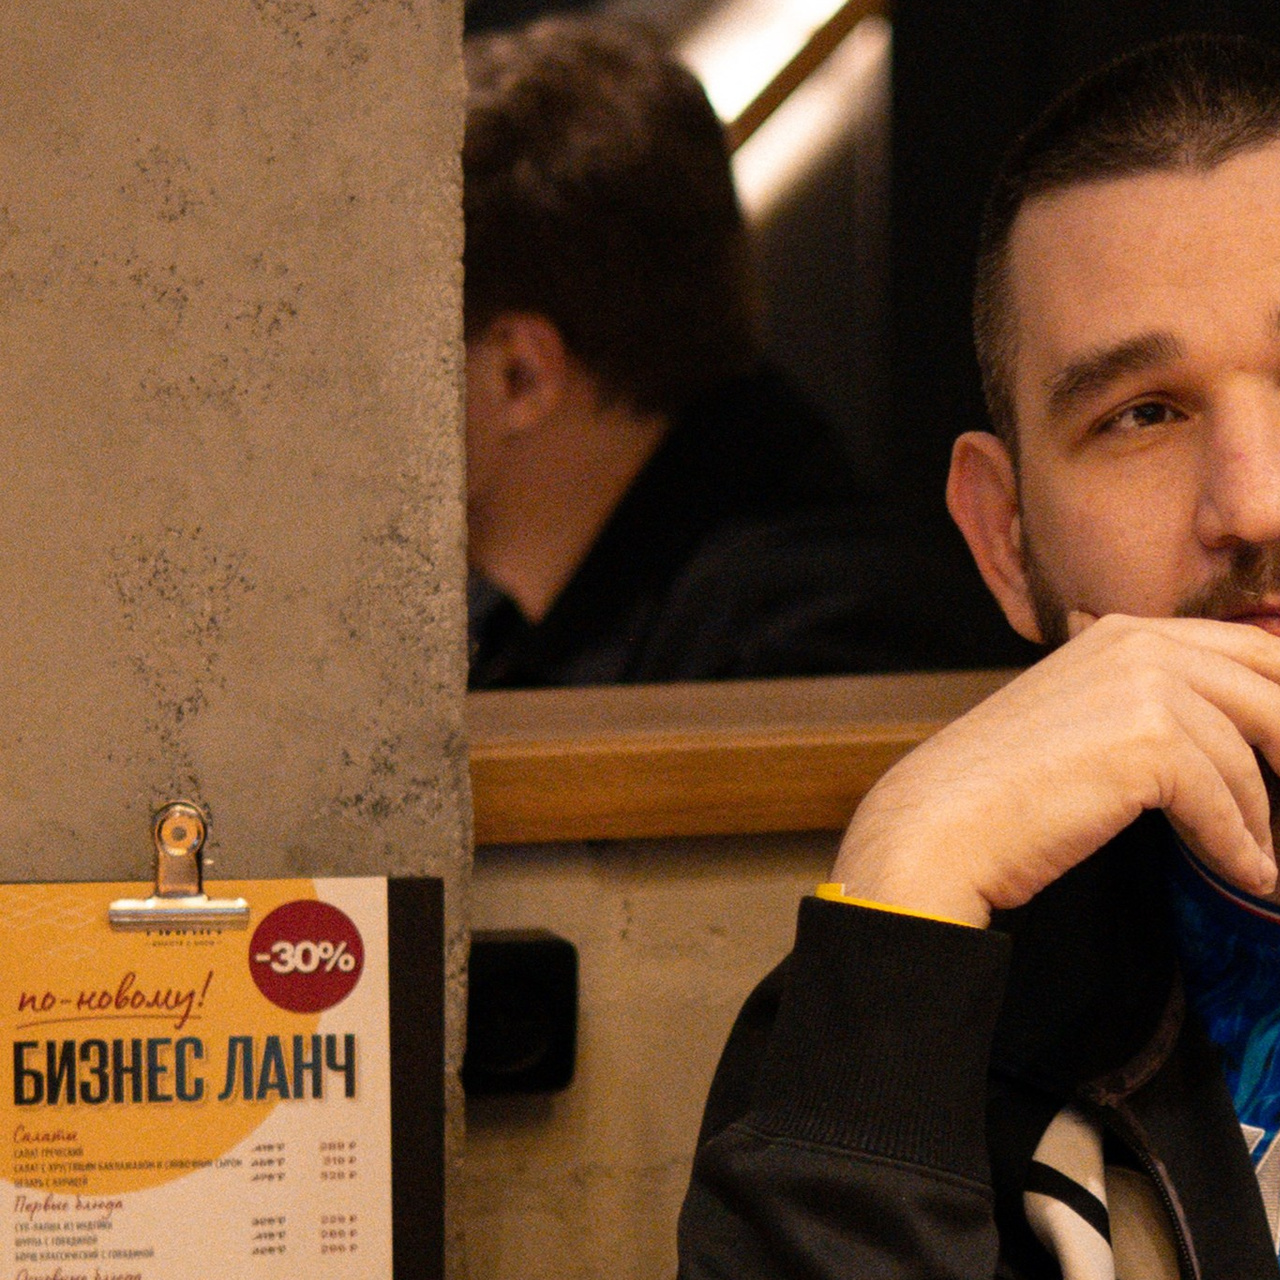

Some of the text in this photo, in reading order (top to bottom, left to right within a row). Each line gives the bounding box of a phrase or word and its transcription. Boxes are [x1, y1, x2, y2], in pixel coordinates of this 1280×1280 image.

[256, 941, 355, 974] -30%
[18, 970, 214, 1030] по-новому!
[13, 1034, 356, 1106] БИЗНЕС ЛАНЧ
[13, 1124, 78, 1144] Салаты
[14, 1194, 124, 1221] Первые блюда
